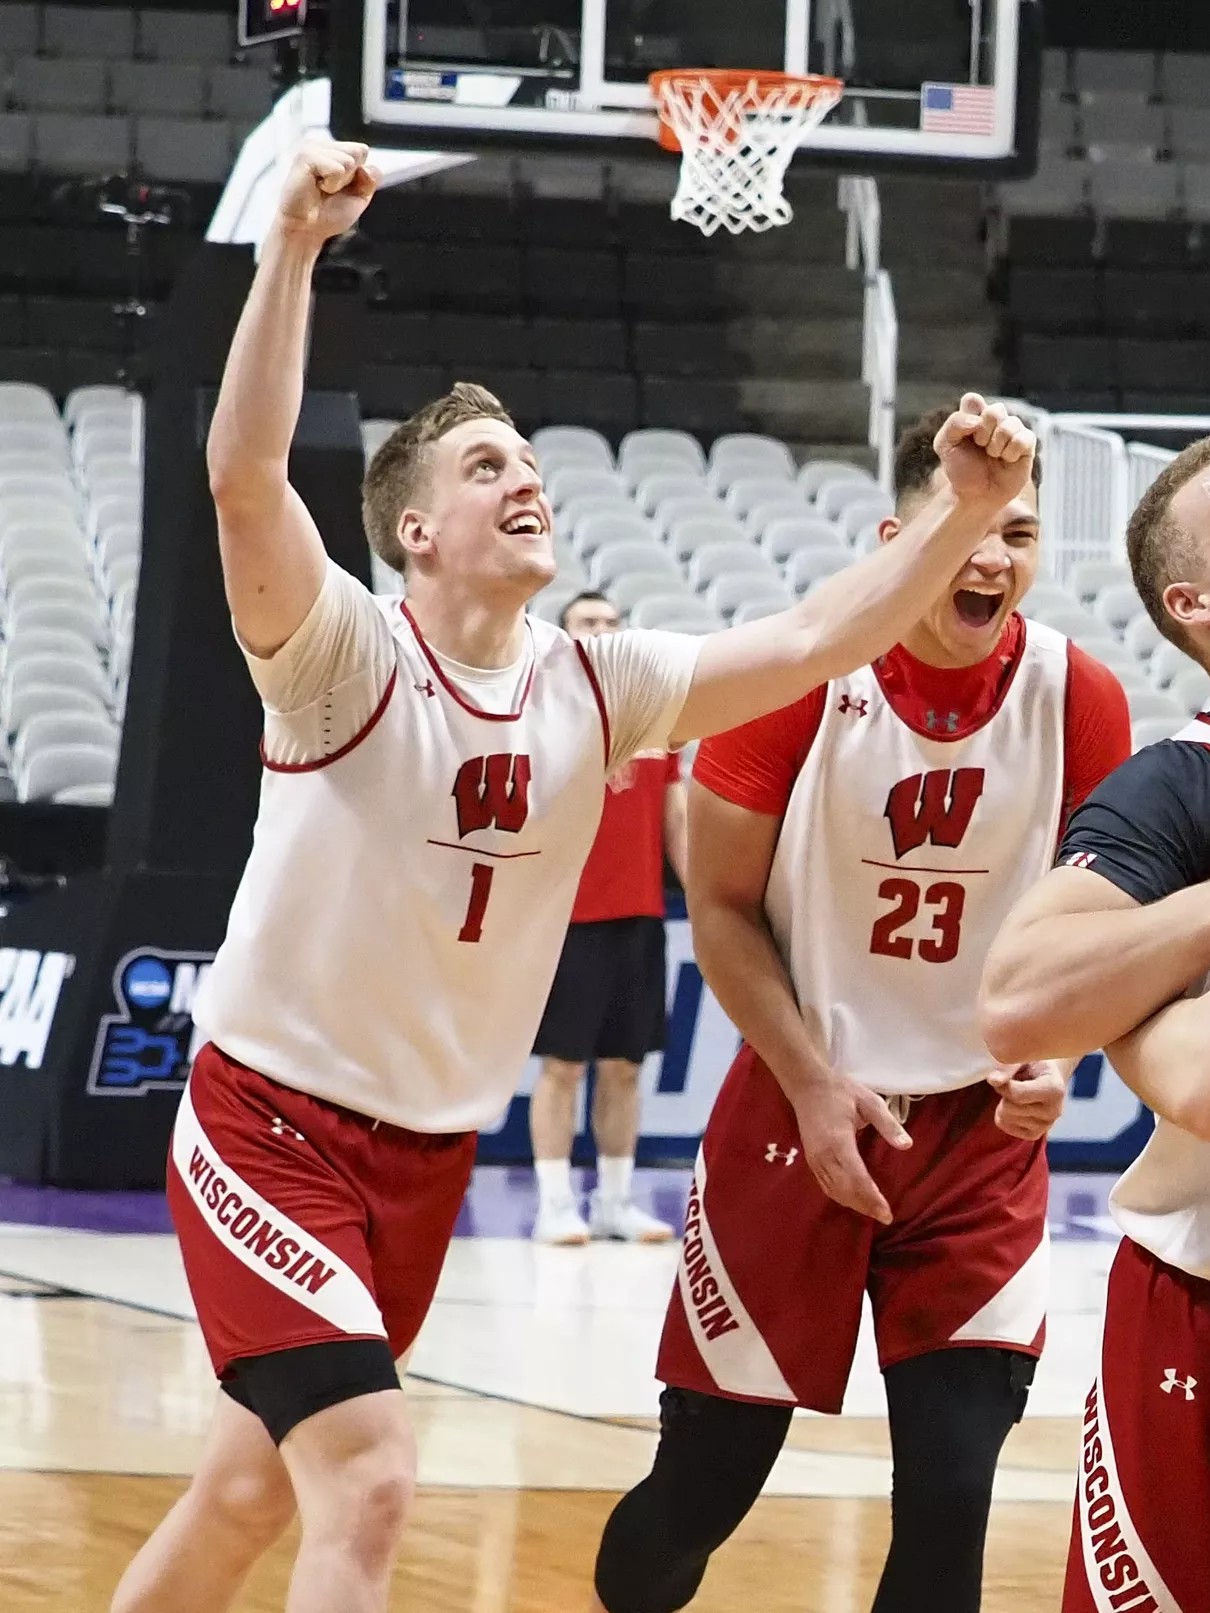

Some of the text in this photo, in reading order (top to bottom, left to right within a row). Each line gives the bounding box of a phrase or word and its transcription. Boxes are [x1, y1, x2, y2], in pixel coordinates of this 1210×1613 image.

[457, 862, 494, 943] 1
[869, 877, 966, 964] 23
[189, 1144, 338, 1295] WISCONSIN
[1083, 1376, 1163, 1613] WISCONSI
